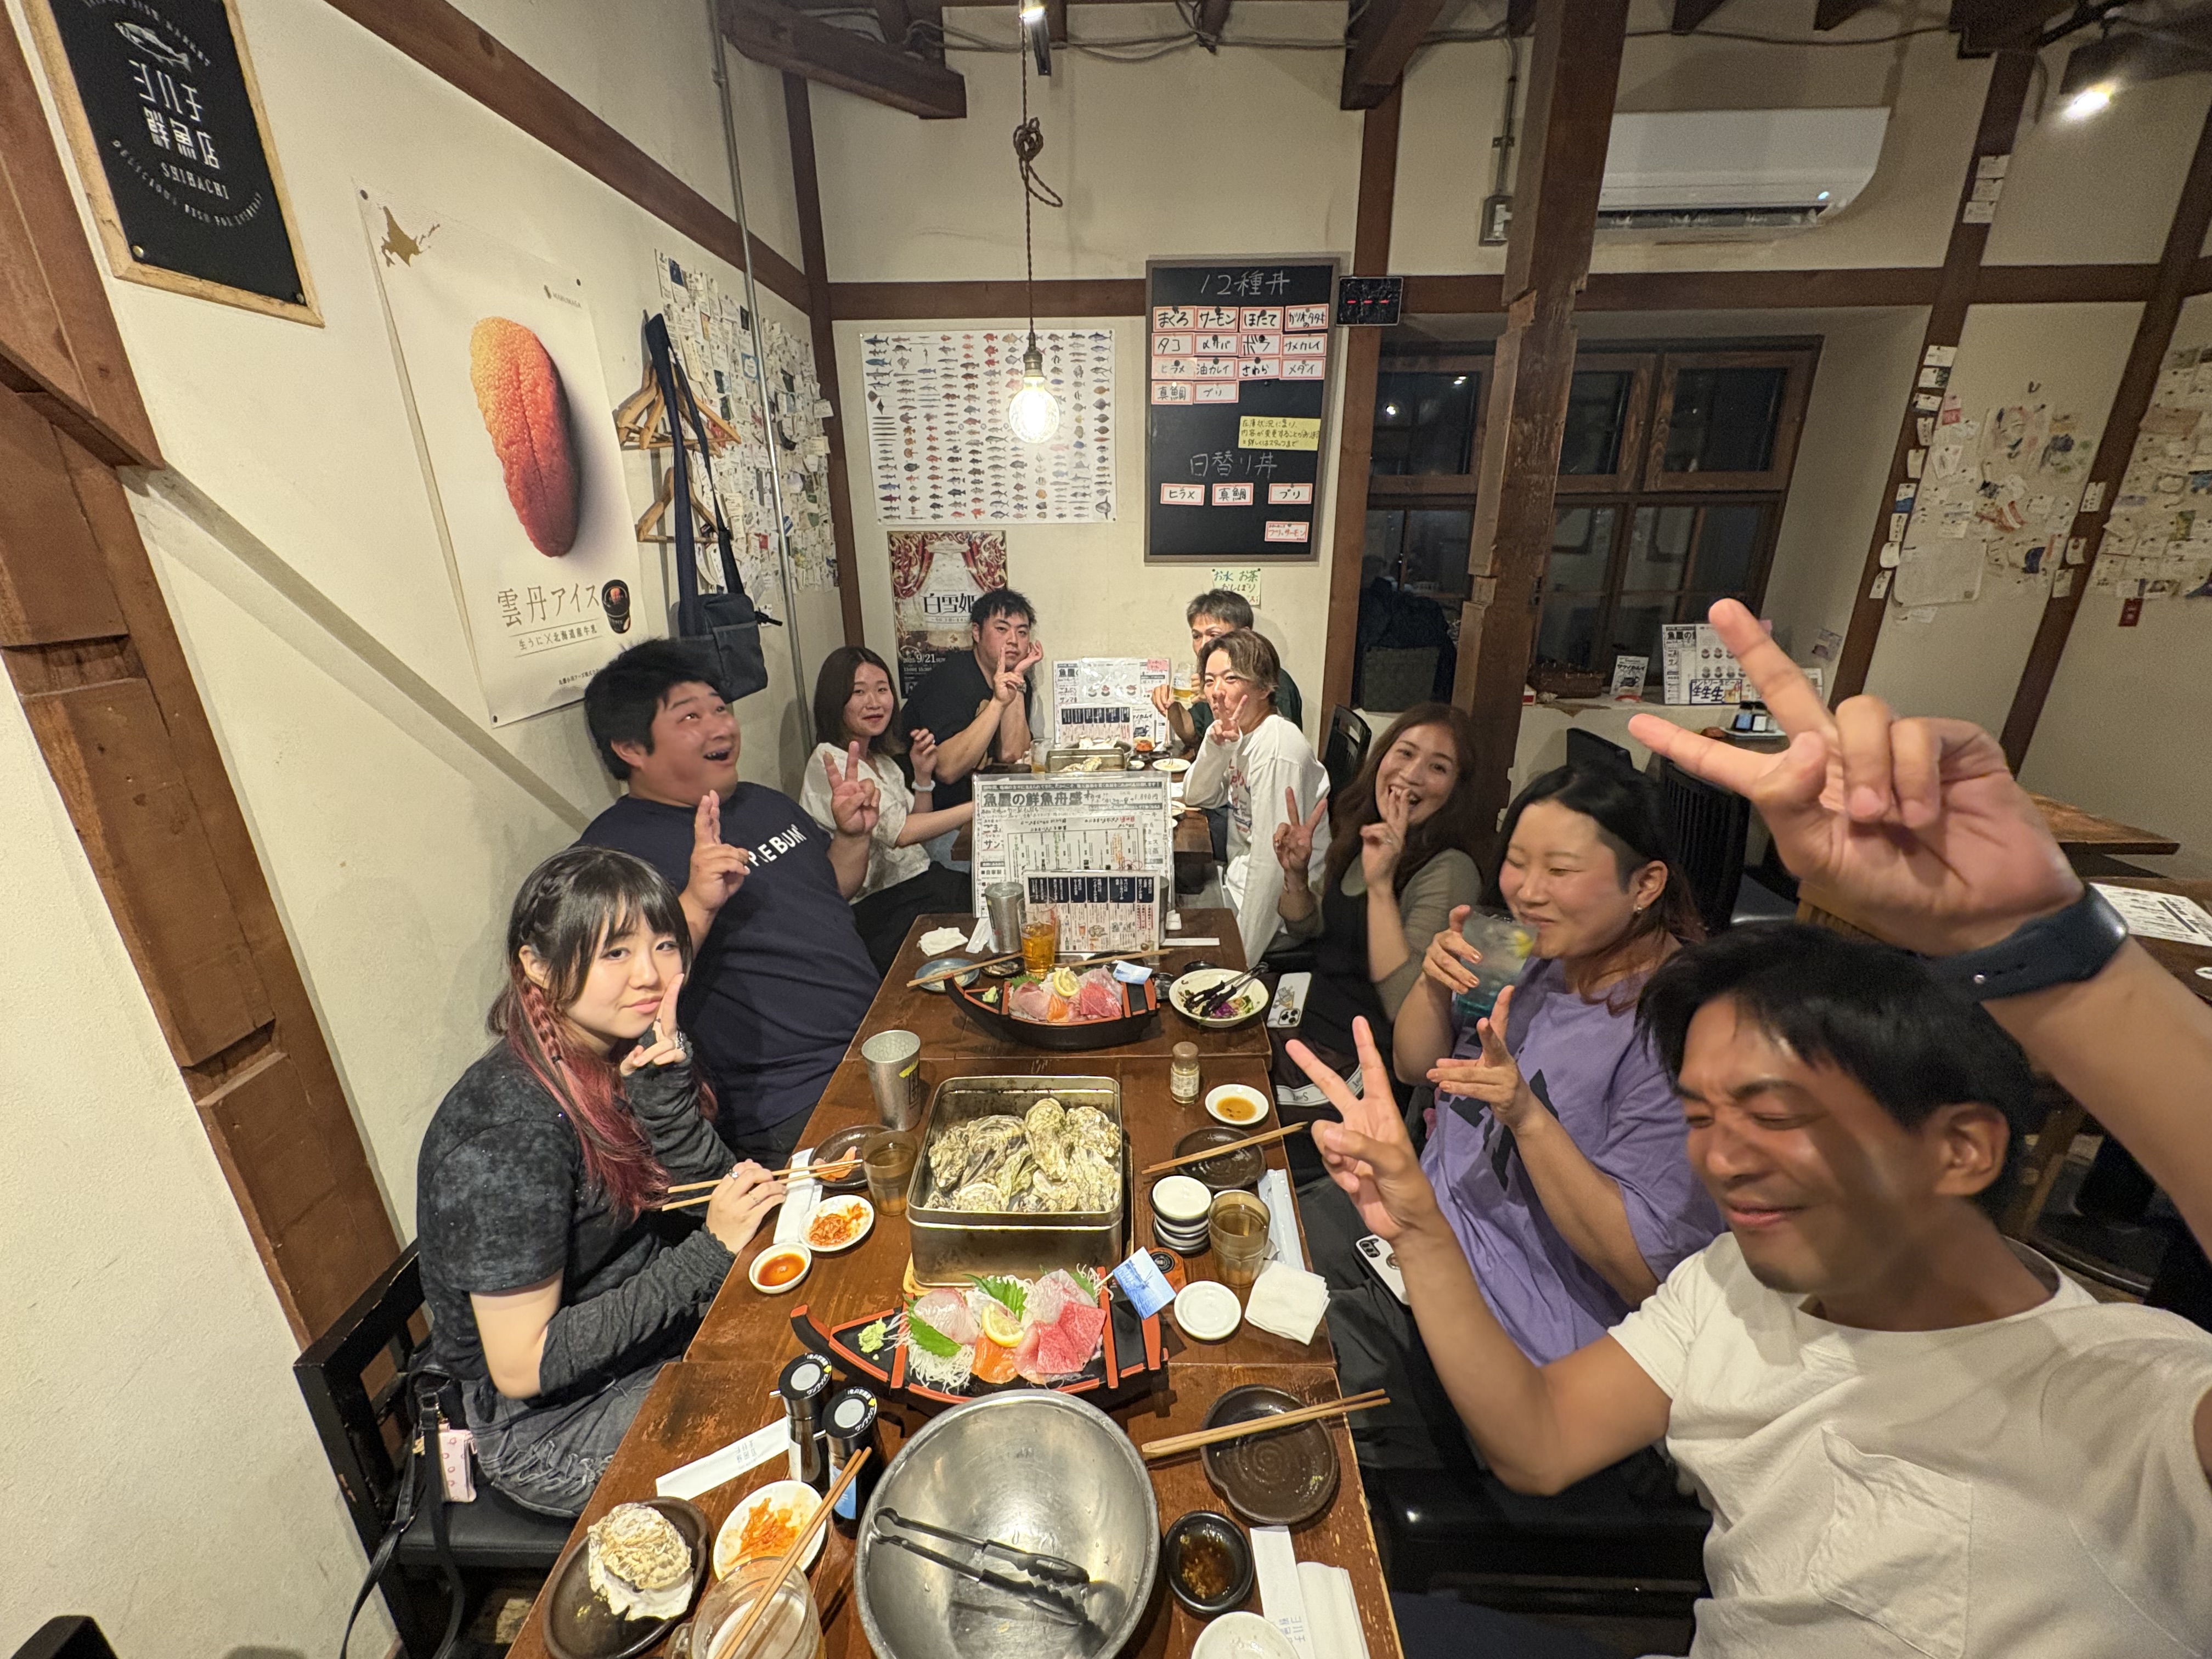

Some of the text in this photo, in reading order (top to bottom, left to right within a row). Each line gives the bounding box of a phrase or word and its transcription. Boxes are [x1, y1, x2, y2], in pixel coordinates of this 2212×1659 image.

[143, 106, 220, 169] 鮮魚店
[161, 162, 229, 200] SHIHACHI
[1158, 311, 1189, 327] まぐろ
[1200, 311, 1235, 328] サーモン
[1244, 311, 1278, 327] ほたて
[1158, 338, 1181, 354] タコ
[1161, 362, 1185, 374] ヒラメ
[1196, 363, 1229, 375] 油カレイ
[1242, 364, 1269, 376] さわら
[1158, 386, 1186, 401] 真鯛
[1203, 388, 1222, 398] ブリ
[1189, 450, 1278, 479] 日替り丼
[1169, 489, 1195, 500] ヒラメ
[1218, 488, 1247, 501] 真鯛
[1279, 488, 1301, 500] ブリ
[1214, 570, 1259, 582] お水 お茶
[497, 583, 600, 628] 雲丹アイス
[916, 653, 936, 664] 9/21
